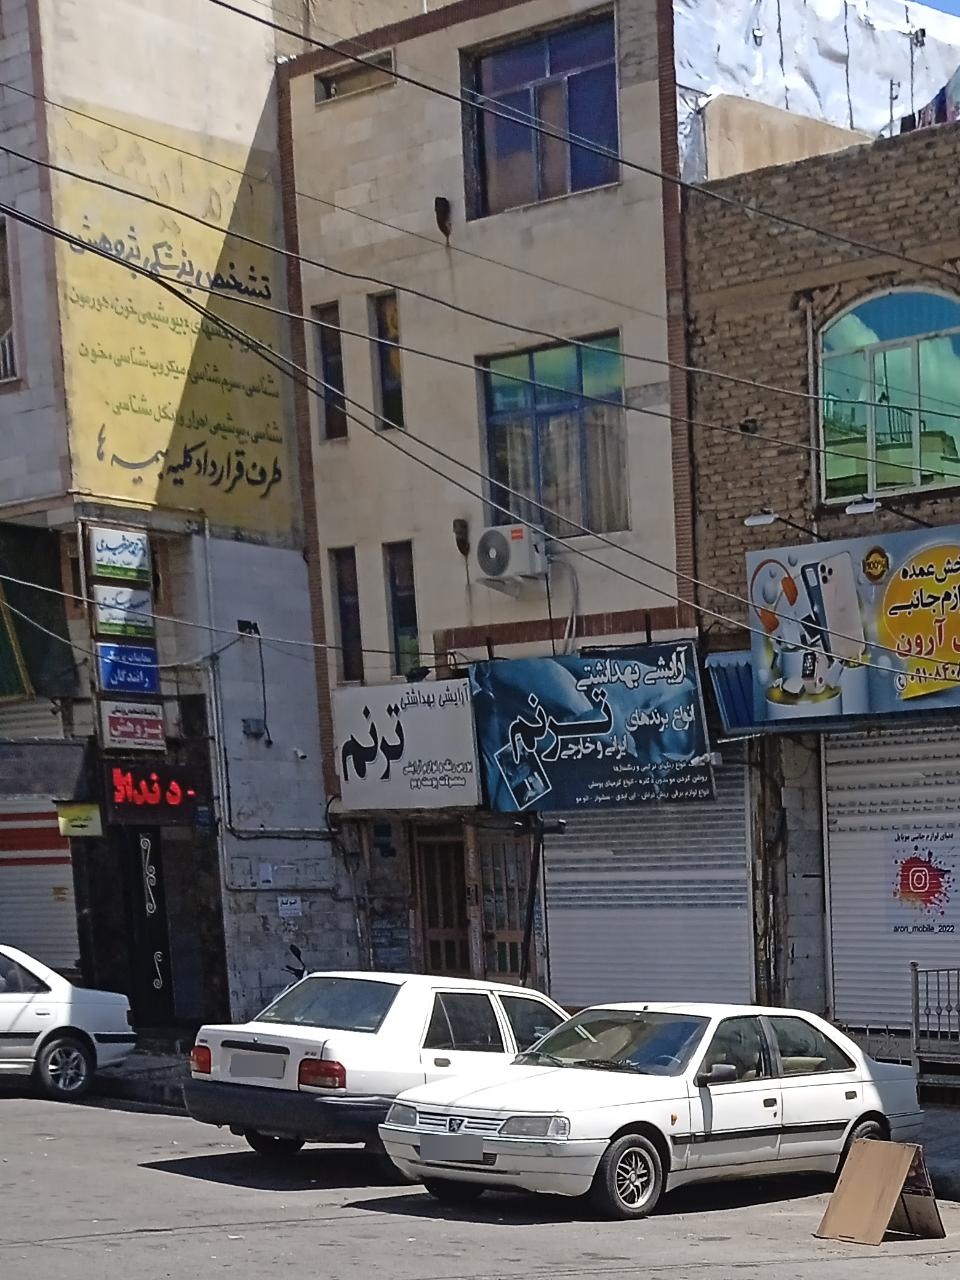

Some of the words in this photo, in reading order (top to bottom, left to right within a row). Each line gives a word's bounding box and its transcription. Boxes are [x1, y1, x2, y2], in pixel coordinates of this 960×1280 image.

[245, 455, 282, 498] طرف
[901, 563, 936, 581] عمده
[887, 587, 942, 616] جانبی
[895, 617, 948, 660] آرون
[575, 657, 641, 691] بهداشتی
[643, 645, 688, 685] آرایشی
[399, 687, 436, 710] بهداشتی
[437, 682, 471, 708] آرایشی
[508, 686, 615, 766] ترنم
[625, 706, 670, 733] برندهای
[671, 703, 696, 732] انواع
[341, 703, 406, 782] ترنم
[559, 736, 596, 760] خارجی
[596, 739, 603, 759] و
[893, 923, 956, 935] aron_mobile_2022
